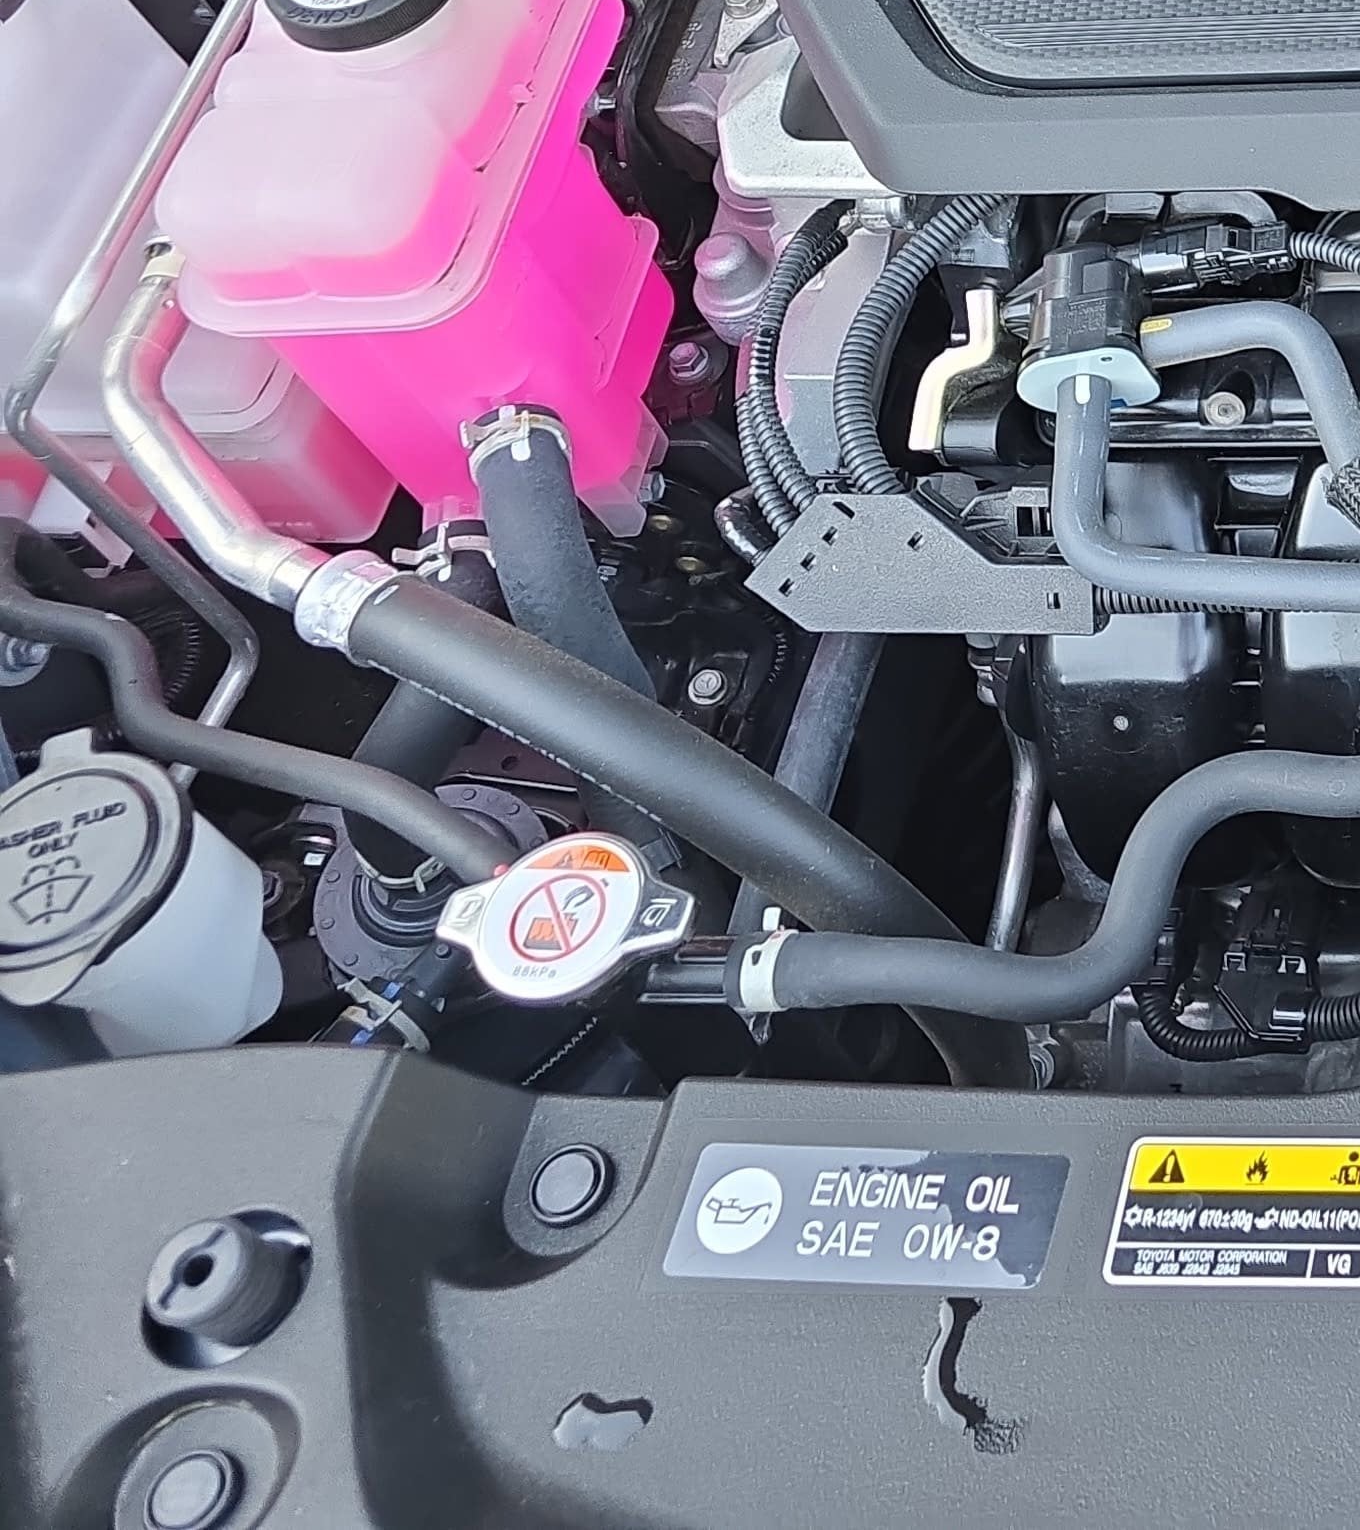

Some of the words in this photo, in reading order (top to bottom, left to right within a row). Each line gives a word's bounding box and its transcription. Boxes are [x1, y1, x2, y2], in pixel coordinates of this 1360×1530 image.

[27, 831, 79, 859] ONLY
[808, 1171, 946, 1211] ENGINE
[964, 1176, 1021, 1214] OIL
[796, 1220, 880, 1258] SAE
[902, 1223, 1001, 1261] 0W-8
[1136, 1249, 1175, 1263] TOYOTA
[1178, 1249, 1215, 1264] MOTOR
[1217, 1250, 1288, 1266] CORPORATION
[1327, 1253, 1352, 1275] VG
